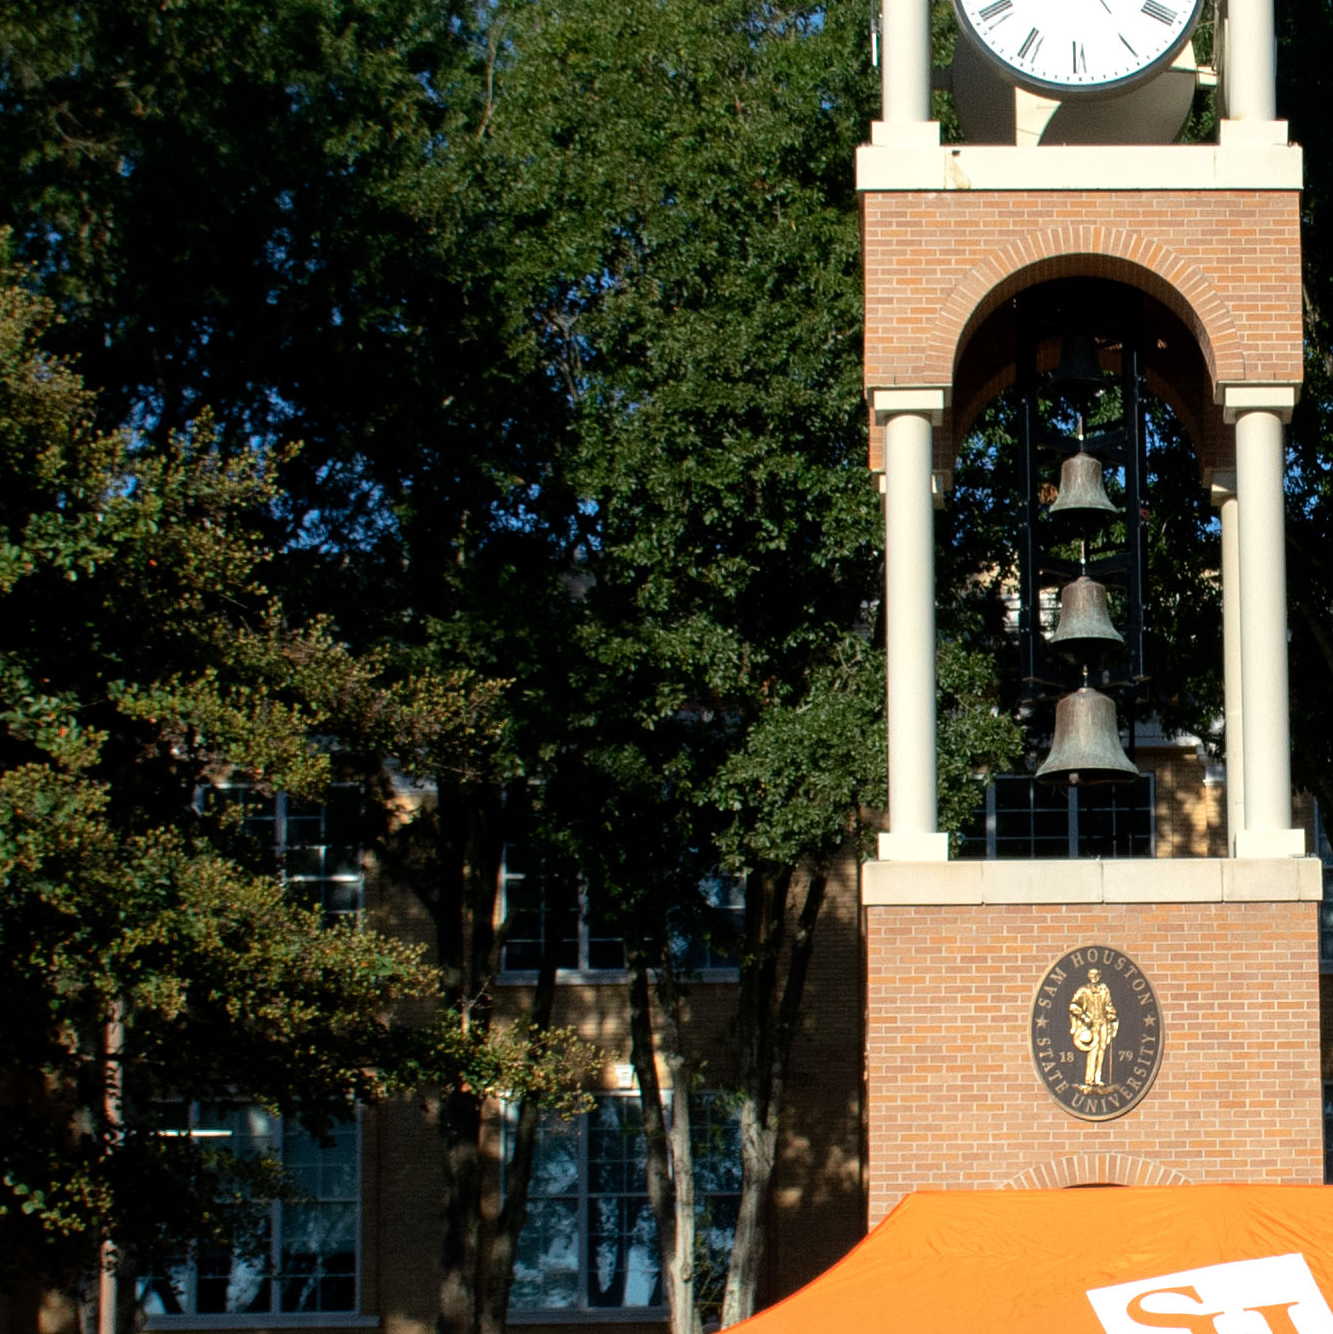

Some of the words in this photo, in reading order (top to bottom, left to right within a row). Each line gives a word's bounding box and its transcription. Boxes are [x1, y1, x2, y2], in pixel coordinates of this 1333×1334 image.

[1038, 968, 1068, 1009] SAM
[1070, 948, 1154, 1005] HOUSTON
[1036, 1038, 1069, 1094] STATE
[1072, 1037, 1156, 1114] UNIVERSITY
[1059, 1051, 1075, 1063] 18
[1119, 1051, 1134, 1062] 79
